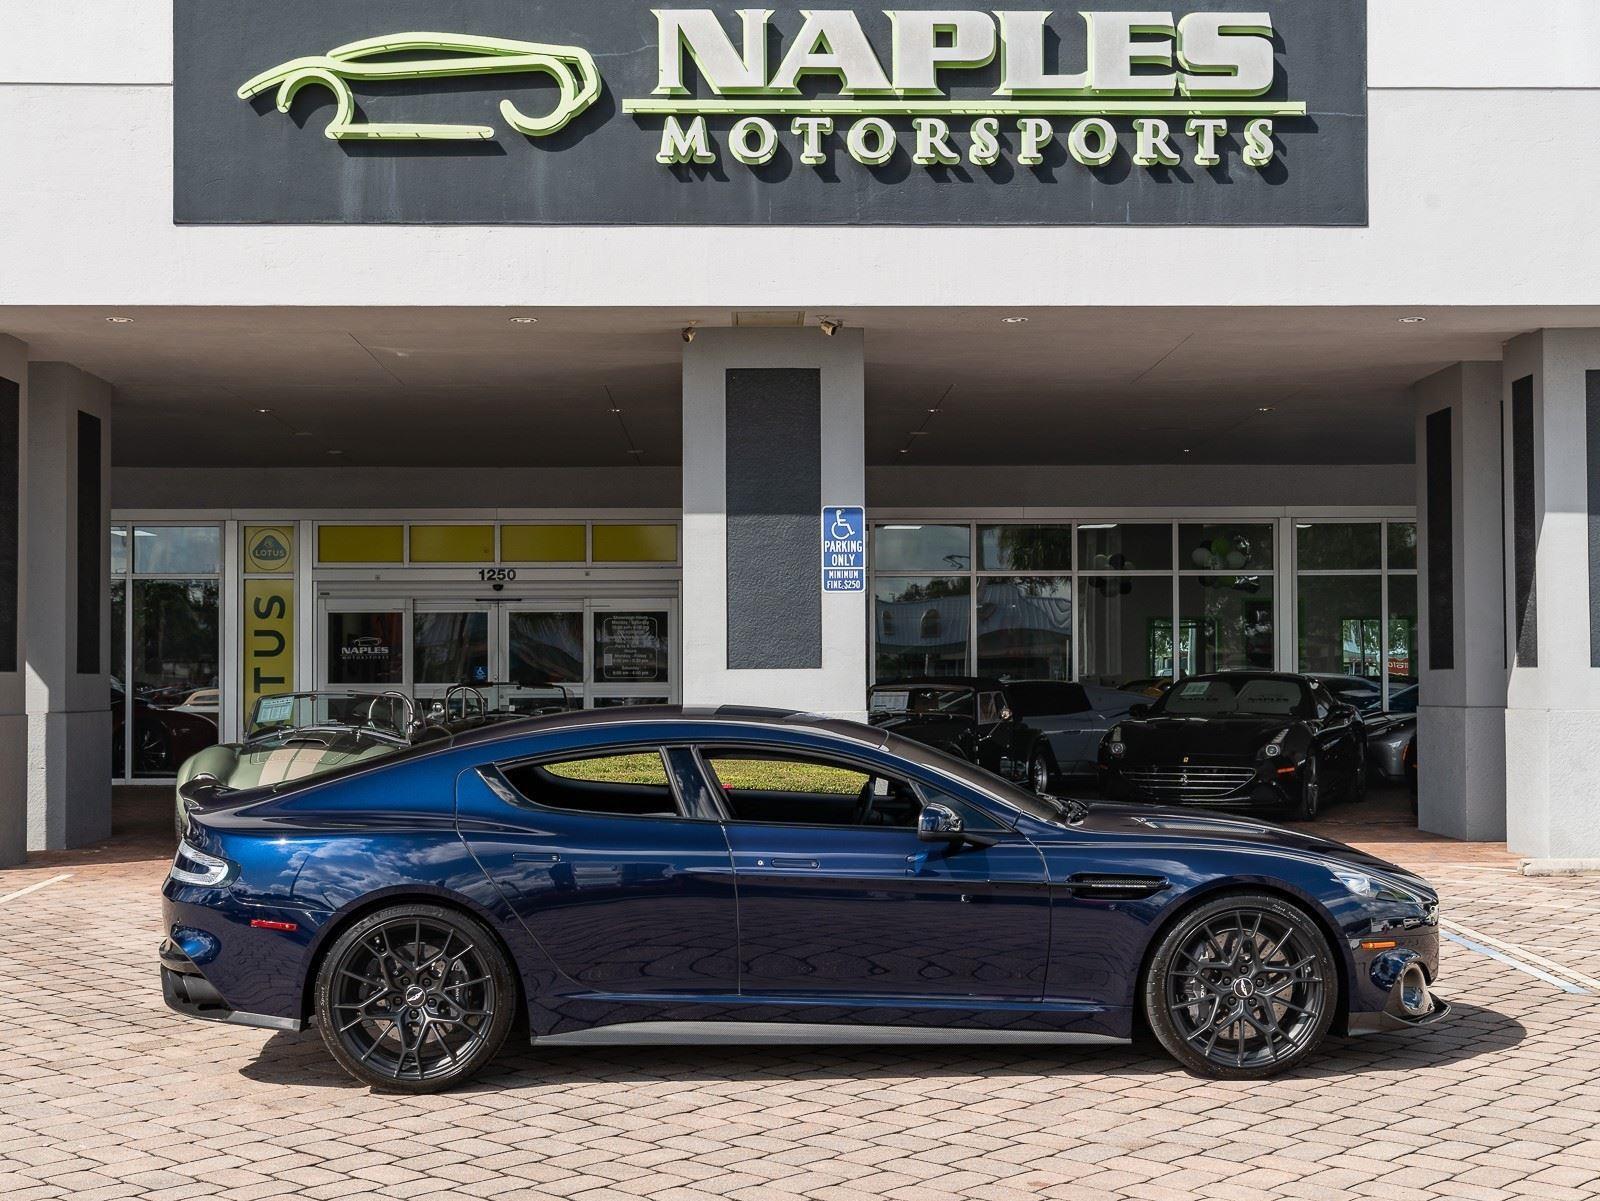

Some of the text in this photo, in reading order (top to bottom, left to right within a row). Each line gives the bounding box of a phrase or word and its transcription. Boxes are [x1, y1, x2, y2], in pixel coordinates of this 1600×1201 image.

[651, 8, 1275, 97] NAPLES
[655, 115, 1275, 168] MOTORSPORTS
[824, 540, 863, 553] PARKING
[255, 549, 285, 557] LOTUS
[831, 553, 856, 566] ONLY
[478, 568, 517, 580] 1250
[828, 570, 859, 579] MINIMUM
[827, 580, 861, 589] FINE $250
[254, 595, 286, 693] TUS
[341, 646, 390, 654] NAPLES
